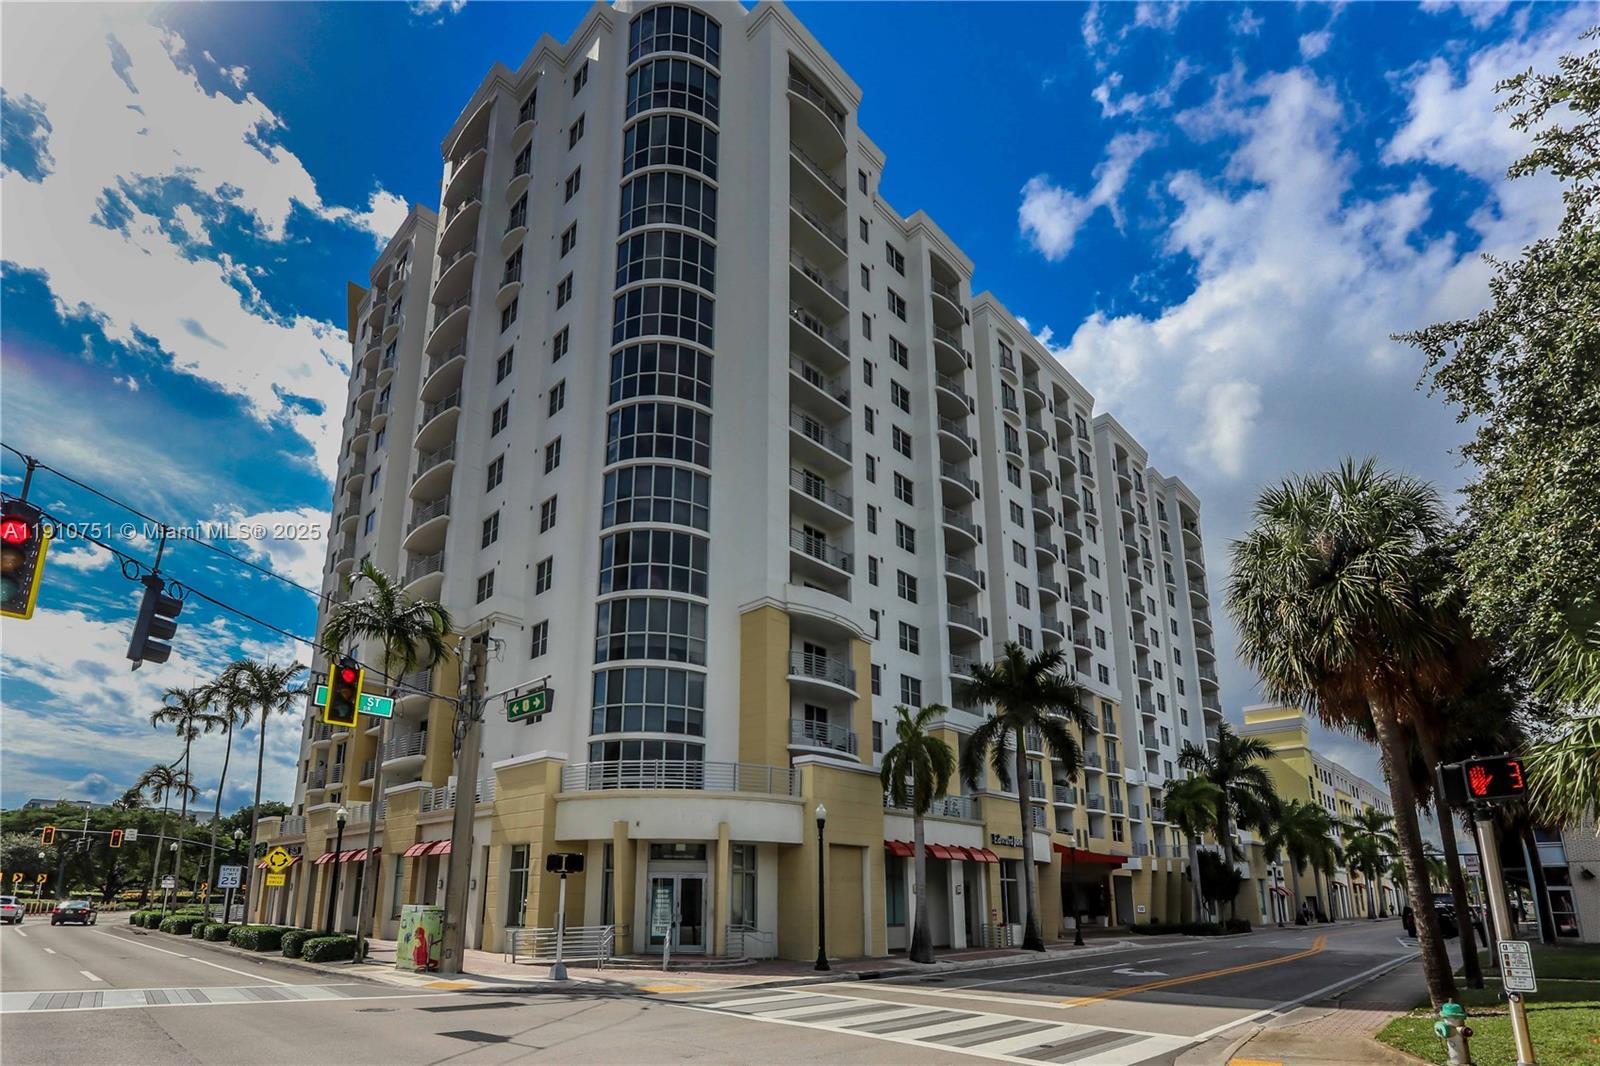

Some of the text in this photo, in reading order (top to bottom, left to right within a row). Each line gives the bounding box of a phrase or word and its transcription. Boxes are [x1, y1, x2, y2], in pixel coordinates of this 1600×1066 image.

[366, 697, 381, 708] ST
[1506, 761, 1524, 789] 3
[220, 876, 239, 886] 25
